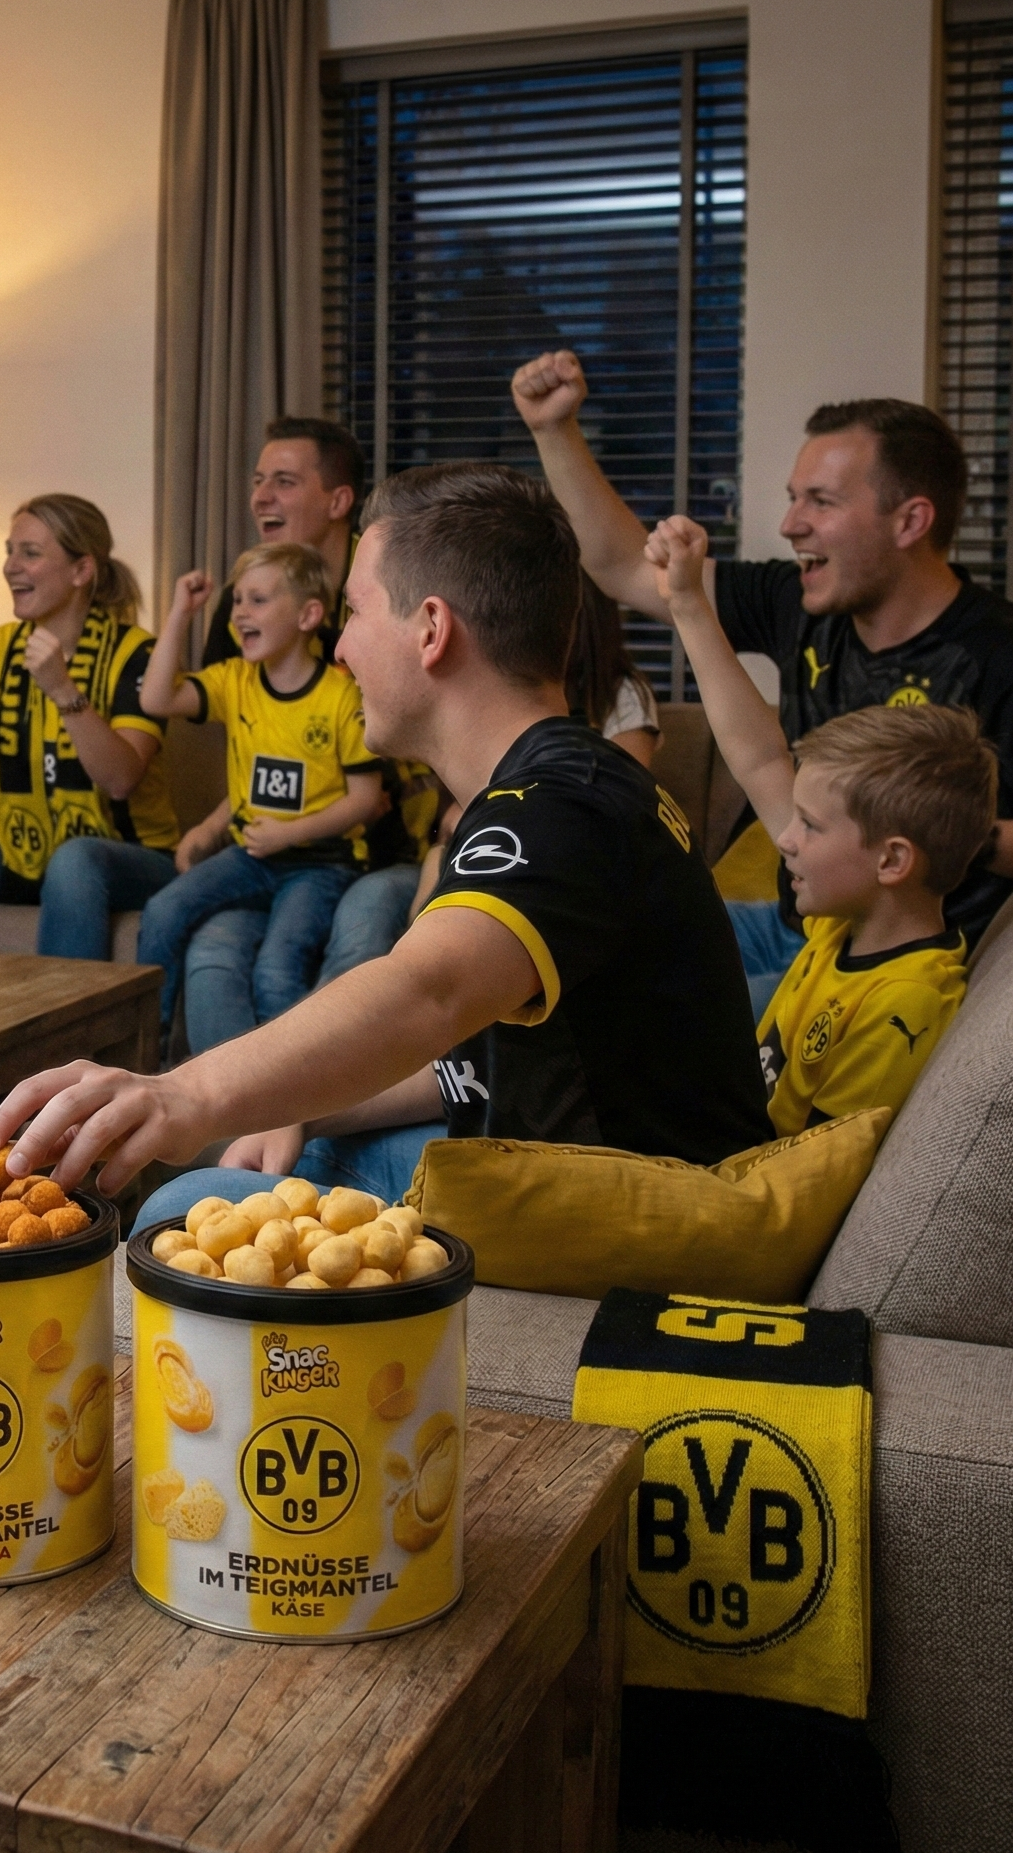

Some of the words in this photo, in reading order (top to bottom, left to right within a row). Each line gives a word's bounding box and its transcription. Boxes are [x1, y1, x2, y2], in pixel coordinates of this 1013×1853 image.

[256, 767, 298, 799] 1&1
[267, 1345, 328, 1372] Snac
[256, 1428, 348, 1497] BVB
[282, 1499, 317, 1523] 09
[637, 1437, 804, 1582] BVB
[199, 1566, 224, 1588] IM
[228, 1552, 369, 1577] ERDNÜSSE
[272, 1598, 325, 1617] KÄSE
[689, 1579, 749, 1630] 09
